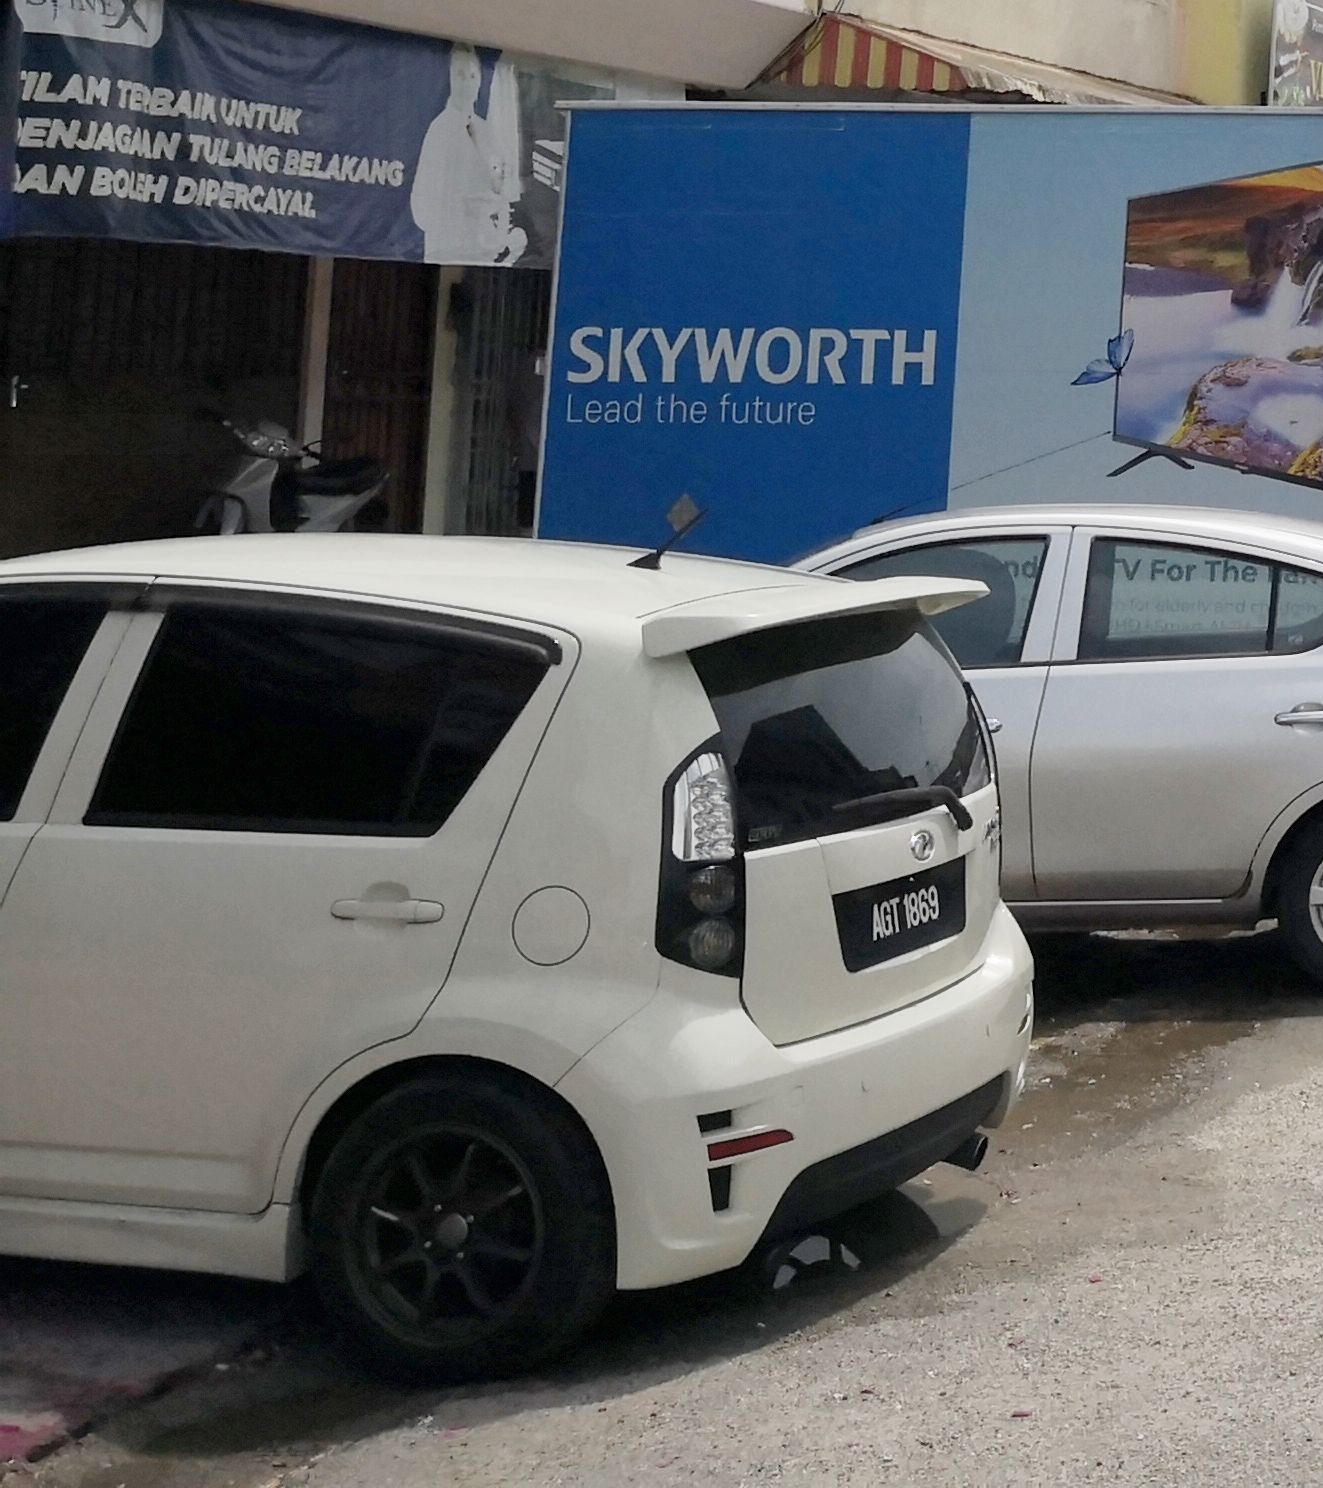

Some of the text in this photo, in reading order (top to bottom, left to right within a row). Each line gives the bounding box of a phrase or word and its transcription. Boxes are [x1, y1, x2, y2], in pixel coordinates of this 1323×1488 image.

[221, 97, 303, 135] UNTUK
[18, 117, 405, 187] ENJAGAAN TULANG BELAKANG
[14, 163, 85, 195] AN
[566, 326, 938, 386] SKYWORTH
[566, 392, 817, 426] Lead the future
[1151, 559, 1197, 582] For
[1205, 559, 1258, 583] The
[872, 885, 940, 941] AGT 1869
